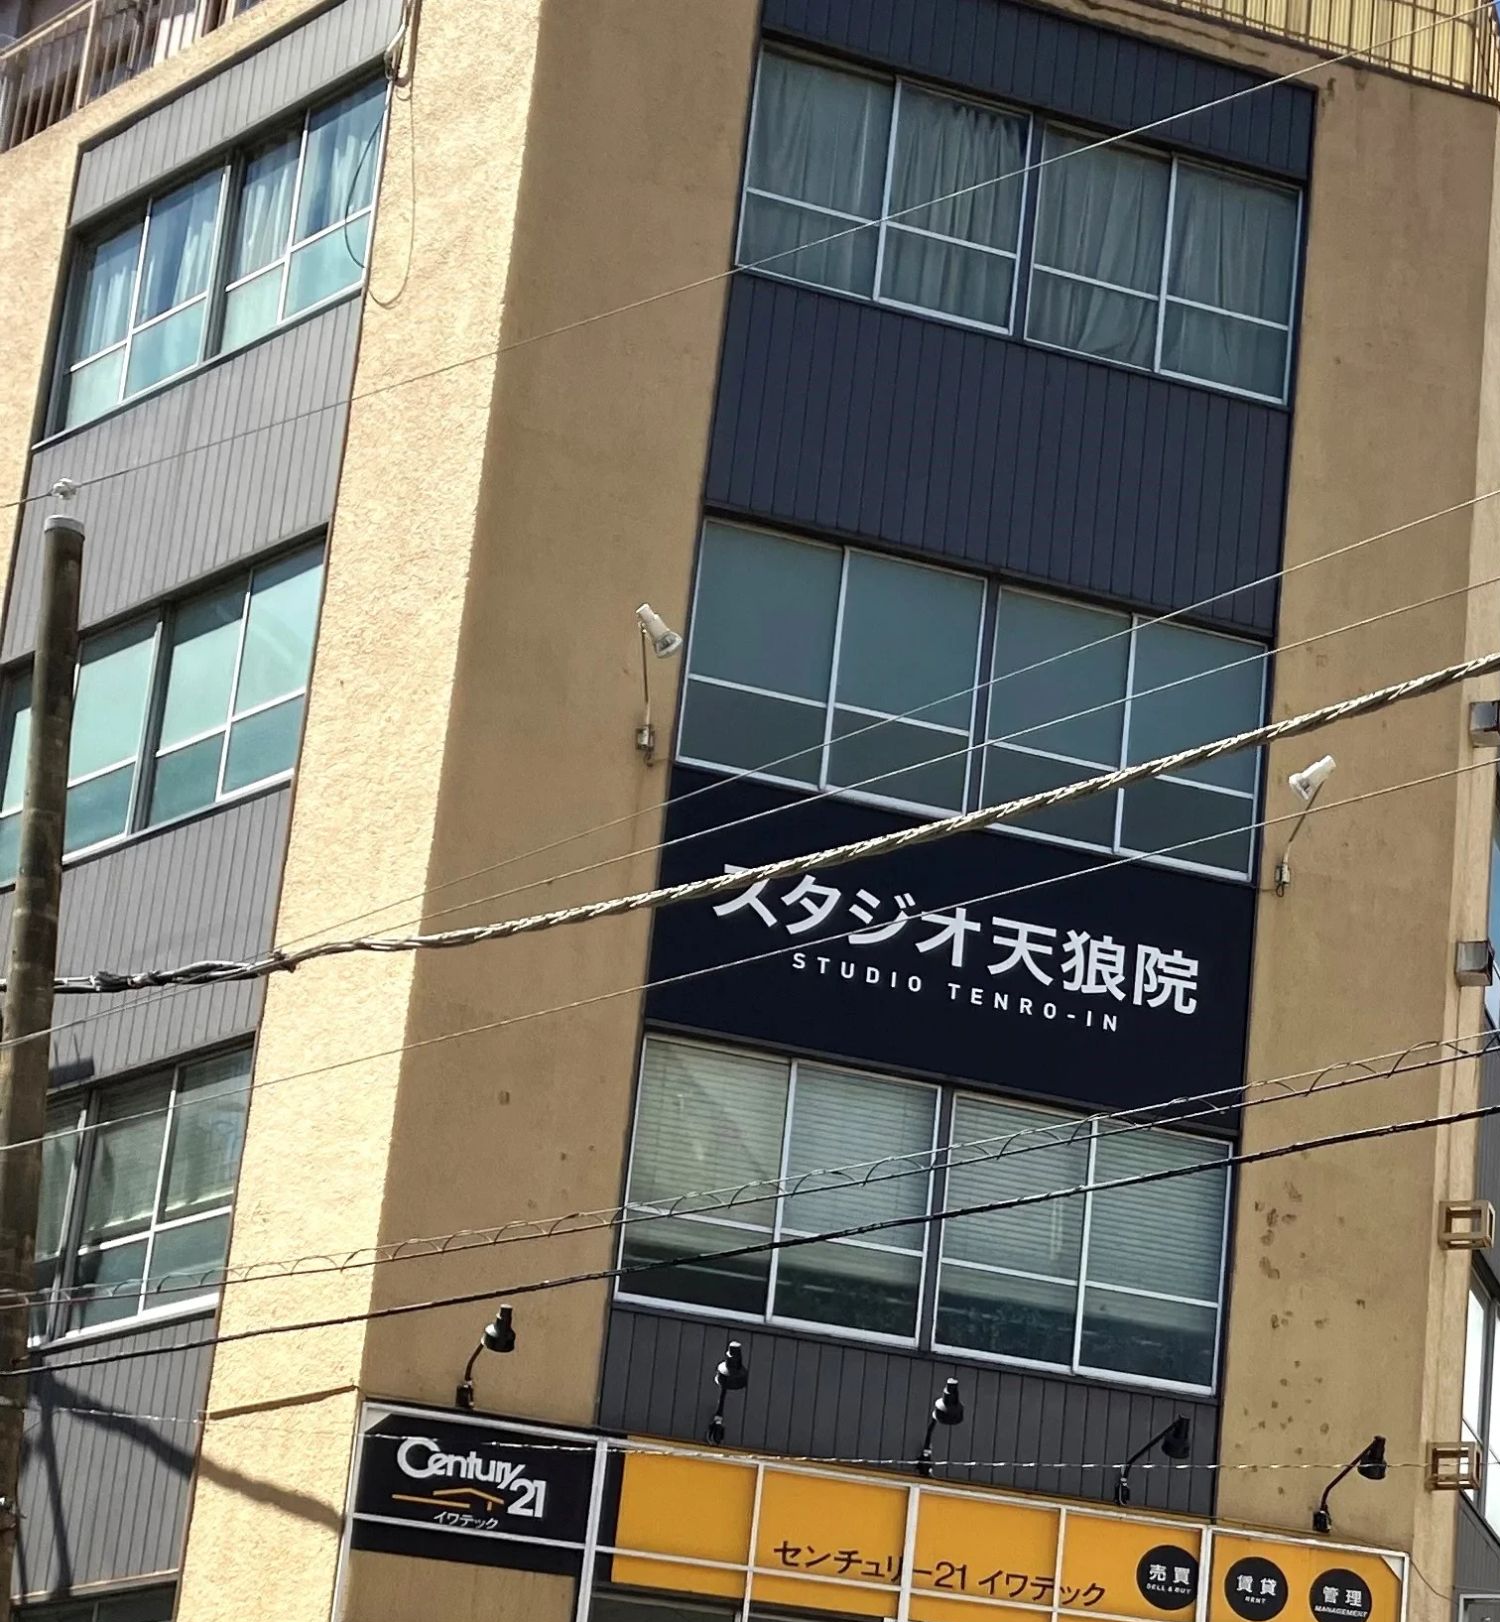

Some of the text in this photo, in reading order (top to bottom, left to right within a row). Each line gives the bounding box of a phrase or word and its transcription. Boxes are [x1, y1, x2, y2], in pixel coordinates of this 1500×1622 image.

[712, 863, 1199, 1015] スタジオ天狼院
[791, 952, 1118, 1032] STUDIO TENRO-IN
[396, 1436, 546, 1517] Century 21
[433, 1510, 499, 1530] イワテック
[1149, 1564, 1190, 1585] 売買
[1236, 1574, 1276, 1596] 賃貸
[978, 1567, 1106, 1607] イワテック
[1323, 1586, 1362, 1607] 管理
[1244, 1595, 1266, 1604] RENT
[1315, 1605, 1368, 1618] MANAGEMENT
